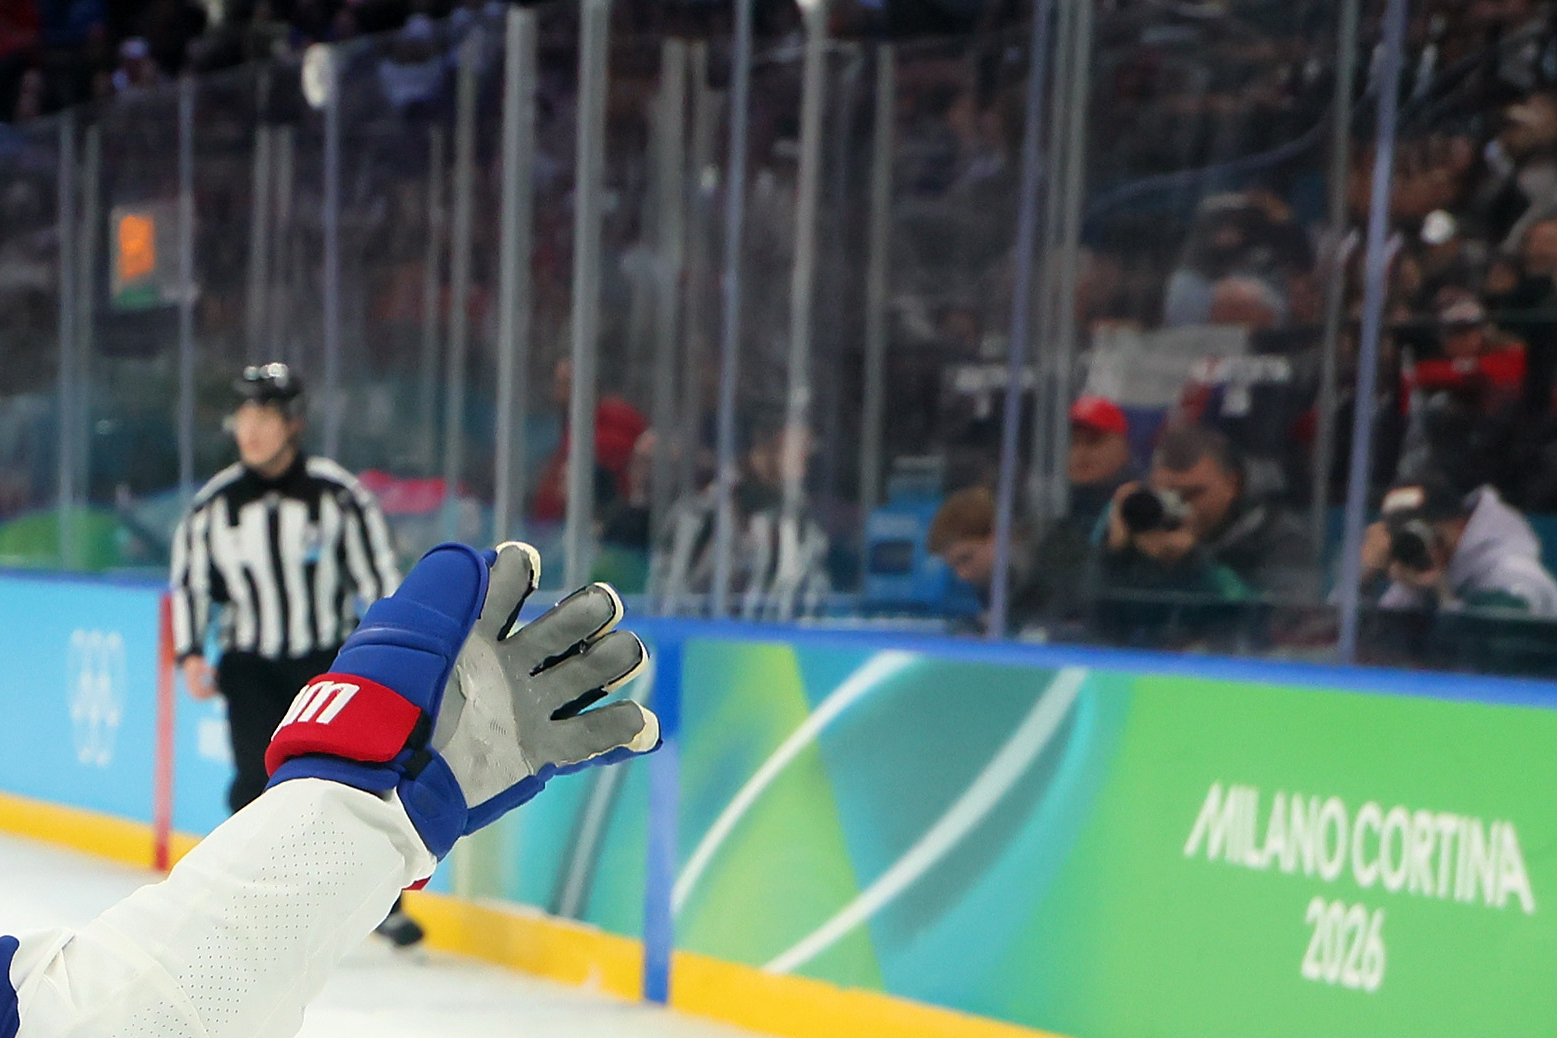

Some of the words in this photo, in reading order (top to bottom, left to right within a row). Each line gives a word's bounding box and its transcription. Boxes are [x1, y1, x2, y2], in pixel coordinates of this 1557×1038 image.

[1184, 782, 1347, 881] MILANO
[1352, 801, 1535, 914] CORTINA
[1300, 896, 1386, 993] 2026
